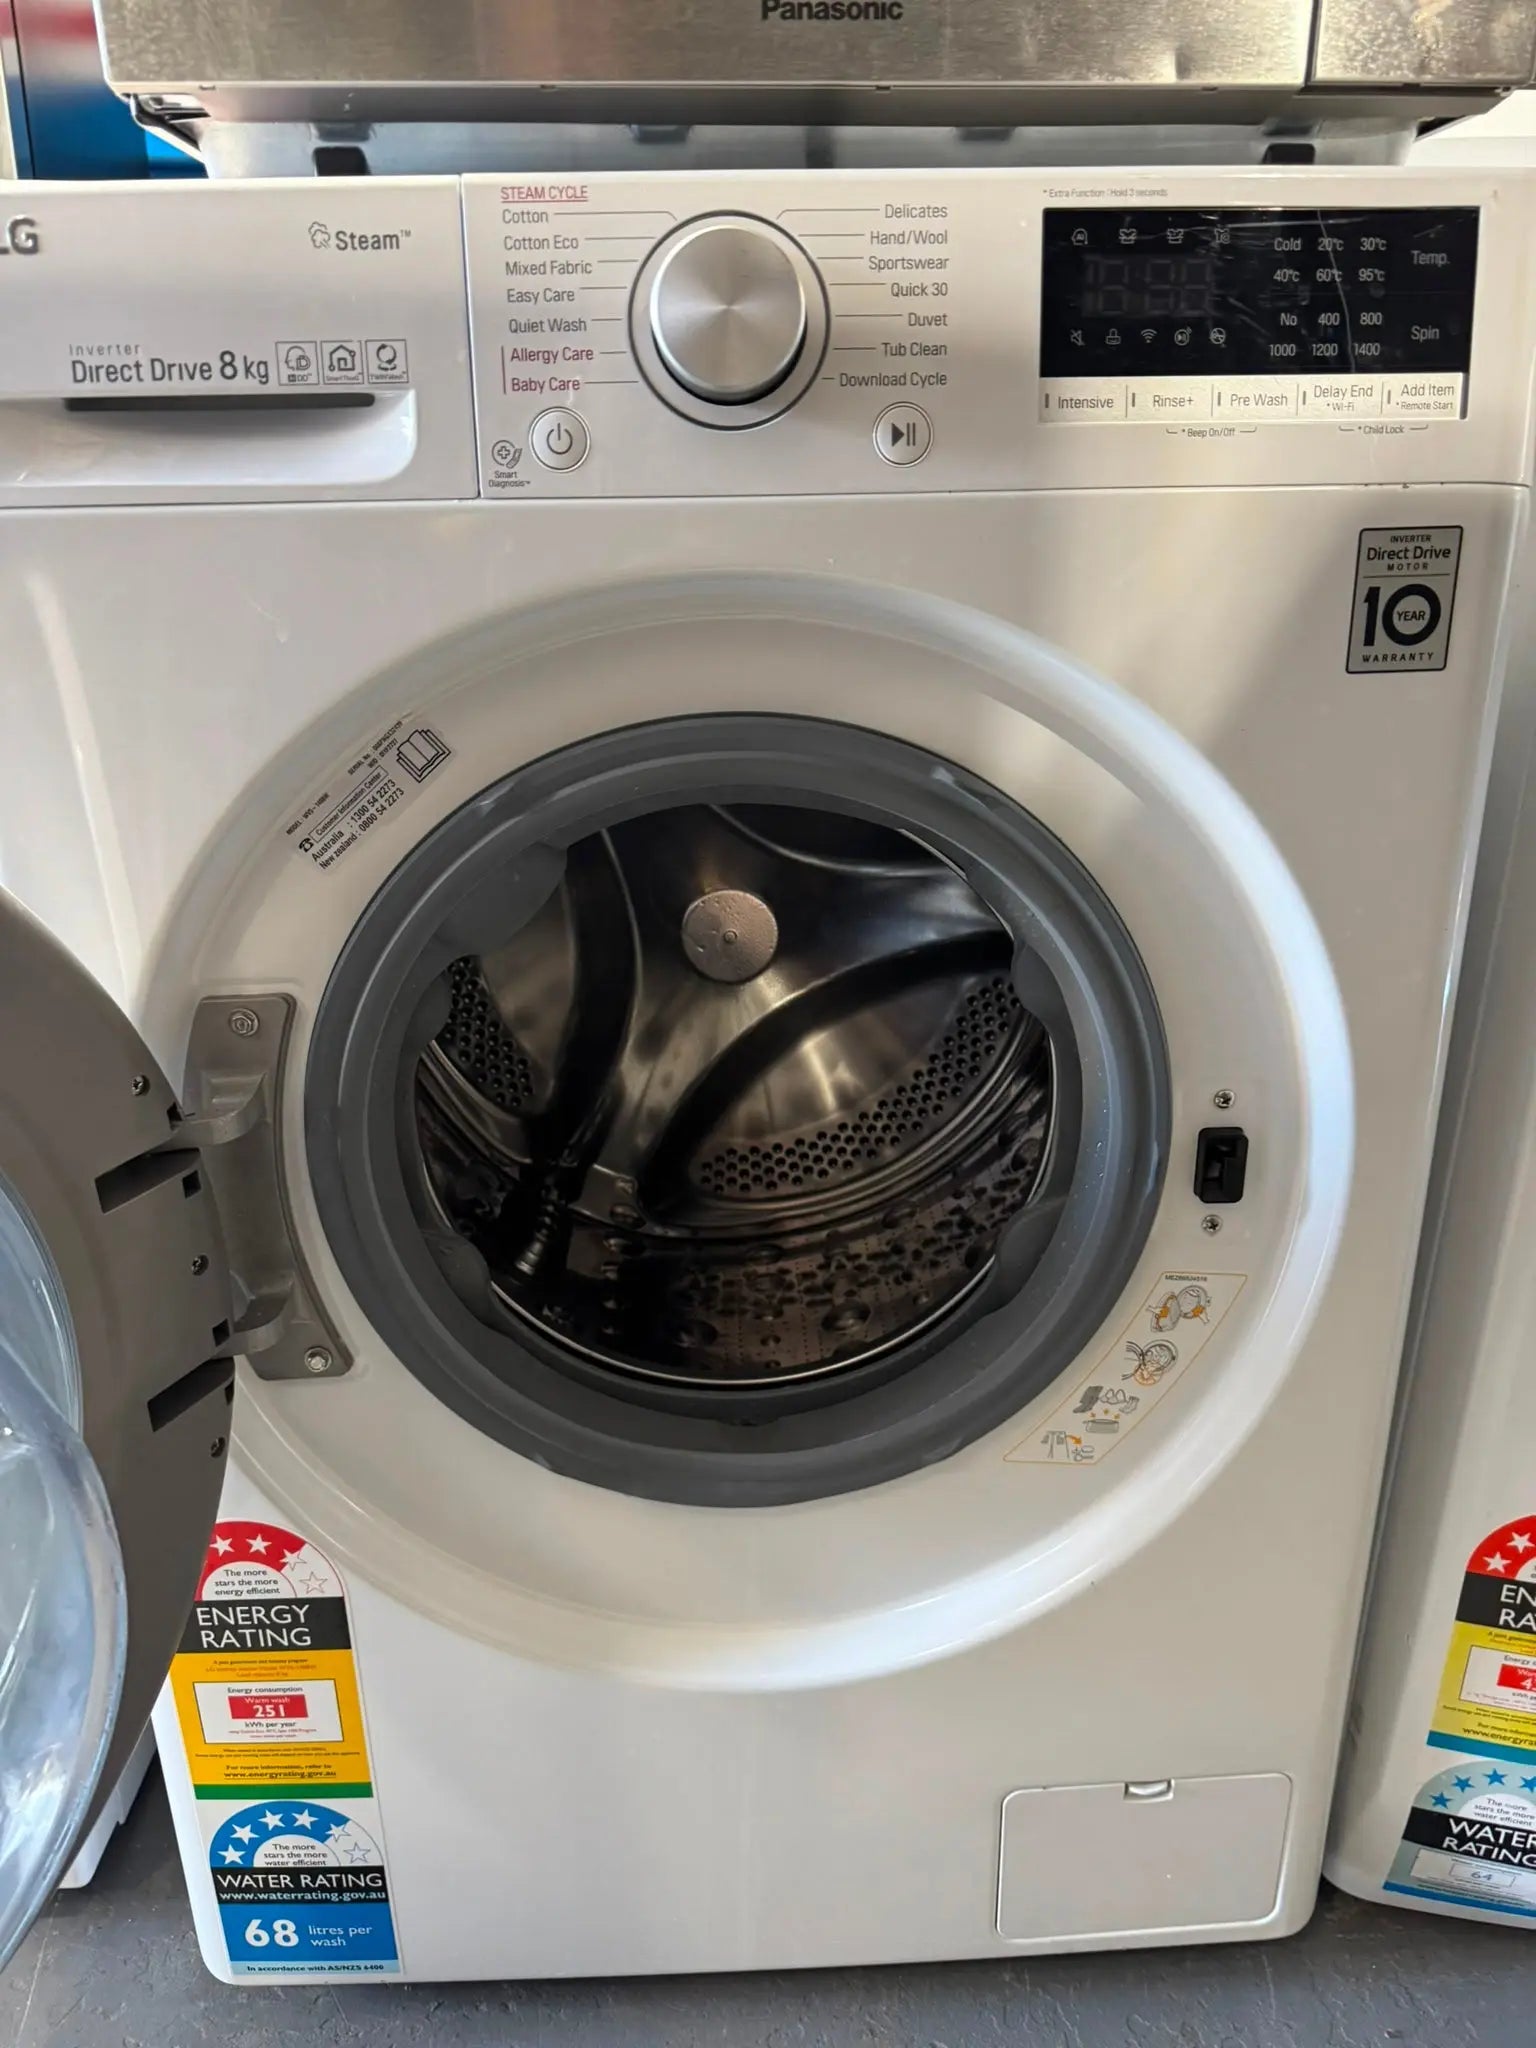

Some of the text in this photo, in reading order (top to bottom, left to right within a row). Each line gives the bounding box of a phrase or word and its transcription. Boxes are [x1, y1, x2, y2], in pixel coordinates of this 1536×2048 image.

[762, 0, 903, 20] Panasonic
[500, 184, 589, 200] STEAM CYCLE
[502, 209, 549, 224] Cotton
[884, 203, 949, 219] Delicates
[503, 235, 579, 251] Cotton Eco
[870, 230, 949, 246] Hand/Wool
[1274, 237, 1301, 251] Cold
[1411, 250, 1450, 268] Temp.
[505, 259, 593, 276] Mixed Fabric
[868, 255, 950, 273] Sportswear
[506, 287, 576, 305] Easy Care
[891, 281, 949, 298] Quick 30
[508, 317, 588, 334] Quiet Wash
[908, 312, 949, 327] Duvet
[1280, 311, 1440, 343] No 400 800 Spin
[69, 343, 141, 357] Inverter
[510, 346, 595, 365] Allergy Care
[881, 341, 948, 358] Tub Clean
[1270, 342, 1381, 357] 1000 1200 1400
[71, 357, 144, 384] Direct
[150, 356, 213, 382] Drive
[511, 376, 581, 395] Baby Care
[839, 371, 948, 389] Download Cycle
[1313, 384, 1373, 400] Delay End
[1400, 383, 1455, 397] Add Item
[1058, 395, 1115, 409] Intensive
[1153, 394, 1194, 408] Rinse+
[1230, 393, 1289, 407] Pre Wash
[1400, 400, 1454, 411] Remote Start
[1187, 427, 1236, 438] Beep On/Off
[1363, 424, 1405, 435] Child Lock
[494, 470, 518, 479] Smart
[1390, 534, 1432, 544] INVERTER
[1366, 545, 1451, 561] Direct Drive
[1387, 562, 1429, 571] MOTOR
[1363, 583, 1442, 647] 10
[1396, 610, 1426, 622] YEAR
[1361, 652, 1435, 663] WARRANTY
[315, 812, 341, 837] Customer
[338, 786, 366, 815] Information
[311, 778, 397, 863] Australia 1300 54 2273
[319, 787, 405, 870] New zealand 0800 54 2273
[224, 1569, 242, 1577] The
[215, 1587, 281, 1597] energy efficient
[196, 1604, 310, 1627] ENERGY
[200, 1627, 312, 1649] RATING
[227, 1686, 304, 1695] Energy consumption
[252, 1704, 286, 1718] 251
[280, 1721, 297, 1729] year
[216, 1873, 383, 1889] WATER RATING
[1470, 1870, 1493, 1881] 64
[218, 1890, 387, 1902] www.waterrating.gov.au
[244, 1918, 300, 1948] 68
[308, 1924, 373, 1937] litres per
[310, 1936, 347, 1948] wash
